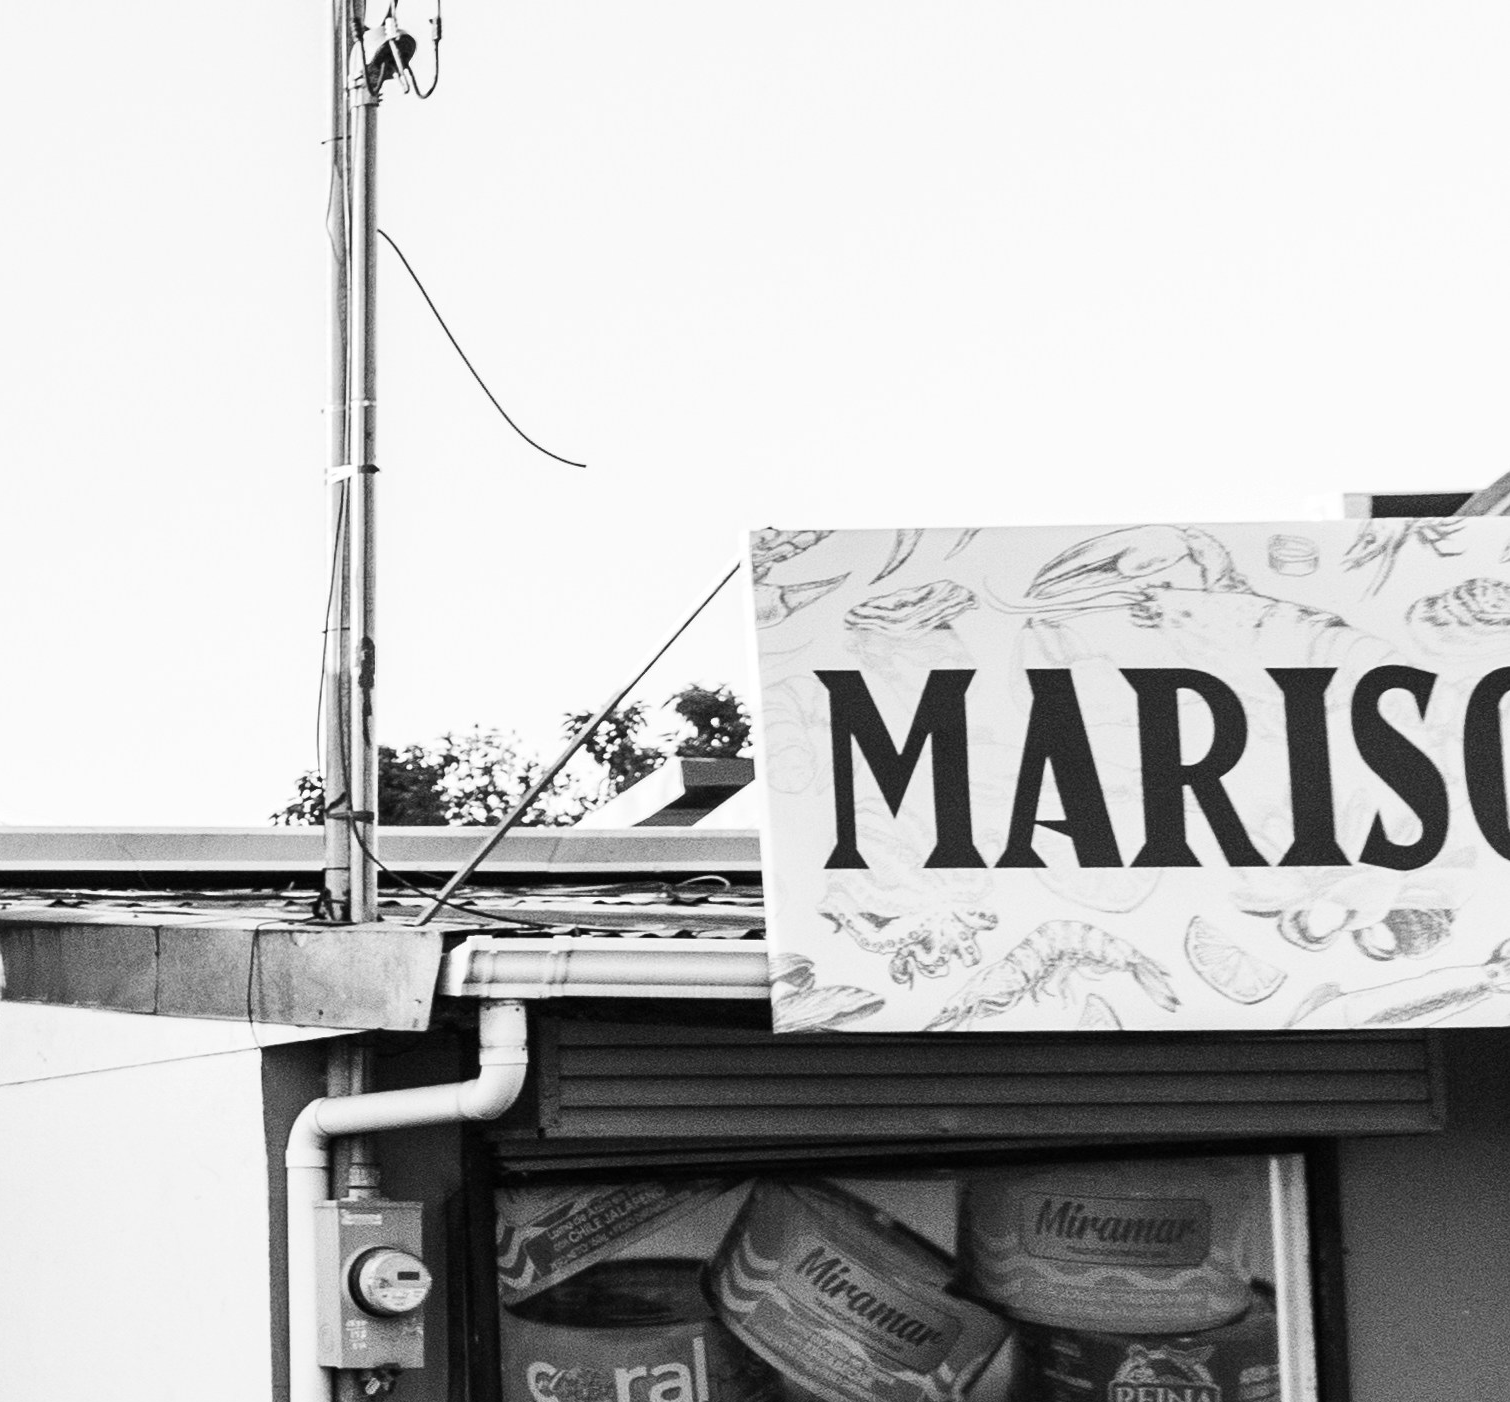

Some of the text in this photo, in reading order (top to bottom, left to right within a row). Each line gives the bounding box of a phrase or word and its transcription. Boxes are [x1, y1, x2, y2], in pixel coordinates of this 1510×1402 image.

[567, 1216, 604, 1243] CHILE
[1035, 1199, 1197, 1244] Miramar
[795, 1246, 944, 1347] Miramar
